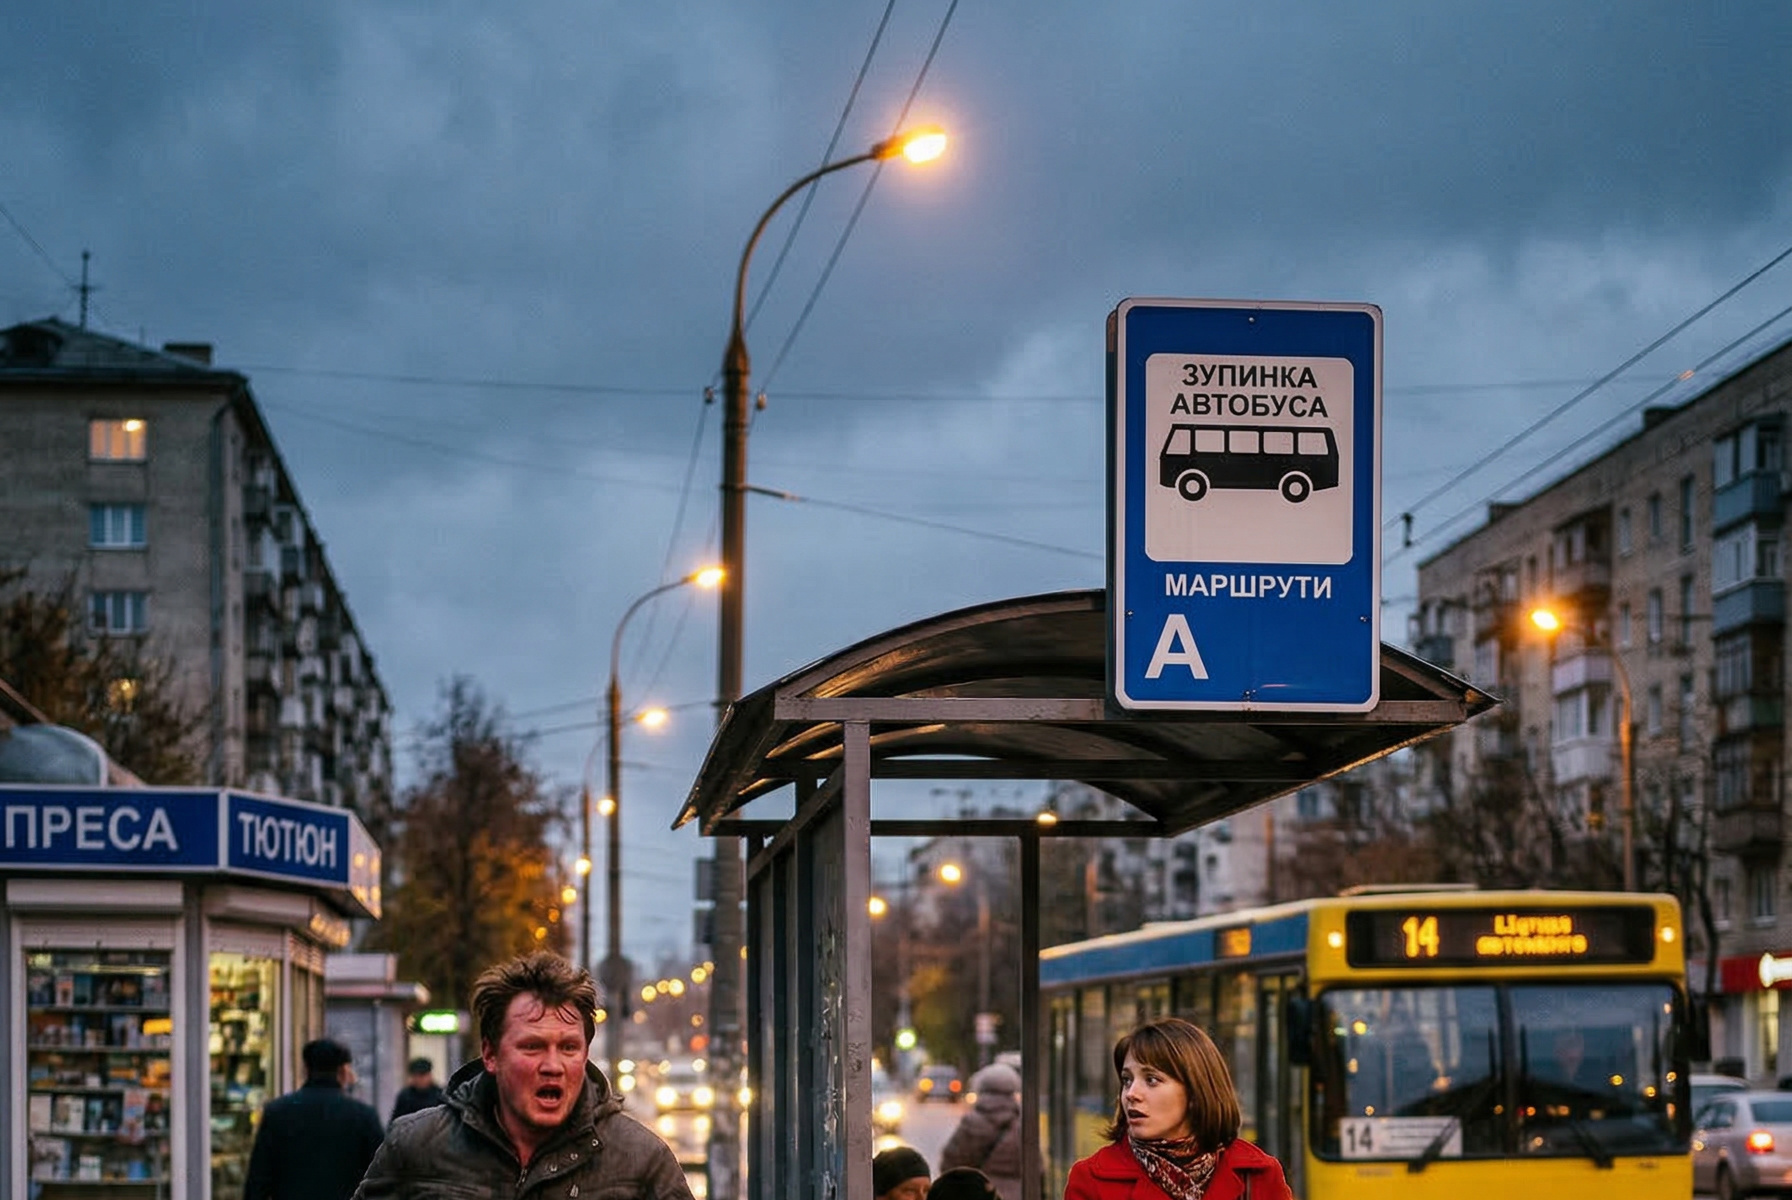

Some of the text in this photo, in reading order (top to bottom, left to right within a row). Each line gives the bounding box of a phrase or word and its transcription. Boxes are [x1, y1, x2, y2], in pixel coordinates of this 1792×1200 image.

[1182, 363, 1318, 389] ЗУПИНКА
[1170, 393, 1329, 418] АВТОБУСА
[1165, 573, 1332, 599] МАРШРУТИ
[1144, 613, 1209, 681] А
[5, 805, 179, 851] ПРЕСА
[238, 811, 337, 869] ТЮТЮН
[1402, 916, 1440, 958] 14
[1346, 1122, 1373, 1153] 14
